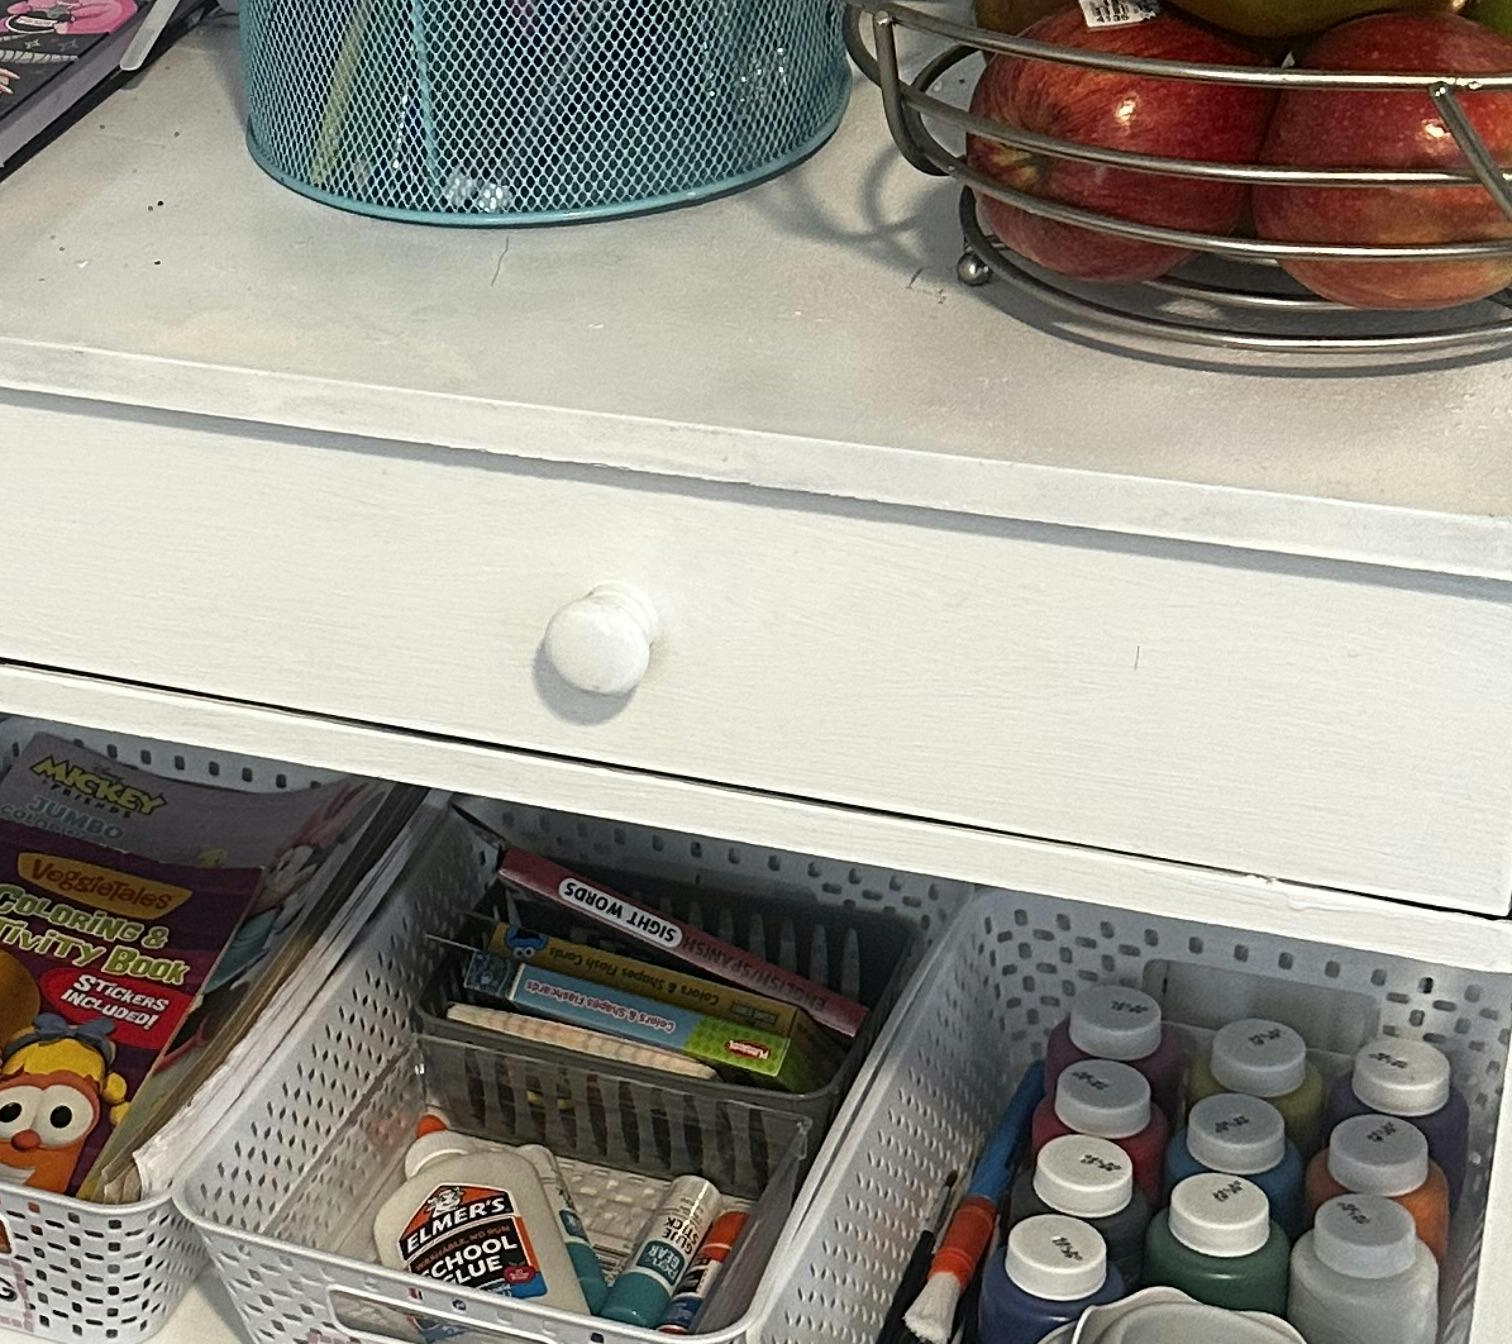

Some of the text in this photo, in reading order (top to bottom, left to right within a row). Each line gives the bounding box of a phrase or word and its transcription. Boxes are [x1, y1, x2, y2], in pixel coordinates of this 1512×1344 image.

[29, 756, 168, 815] MICKEY
[28, 795, 123, 839] JUMBO
[31, 859, 173, 910] VeggieTales
[563, 881, 677, 943] SIGHT WORDS
[140, 926, 169, 950] &
[407, 1197, 505, 1254] ELMER'S
[662, 1228, 695, 1255] GLUE
[665, 1215, 699, 1243] STICK
[647, 1244, 681, 1272] GEAR
